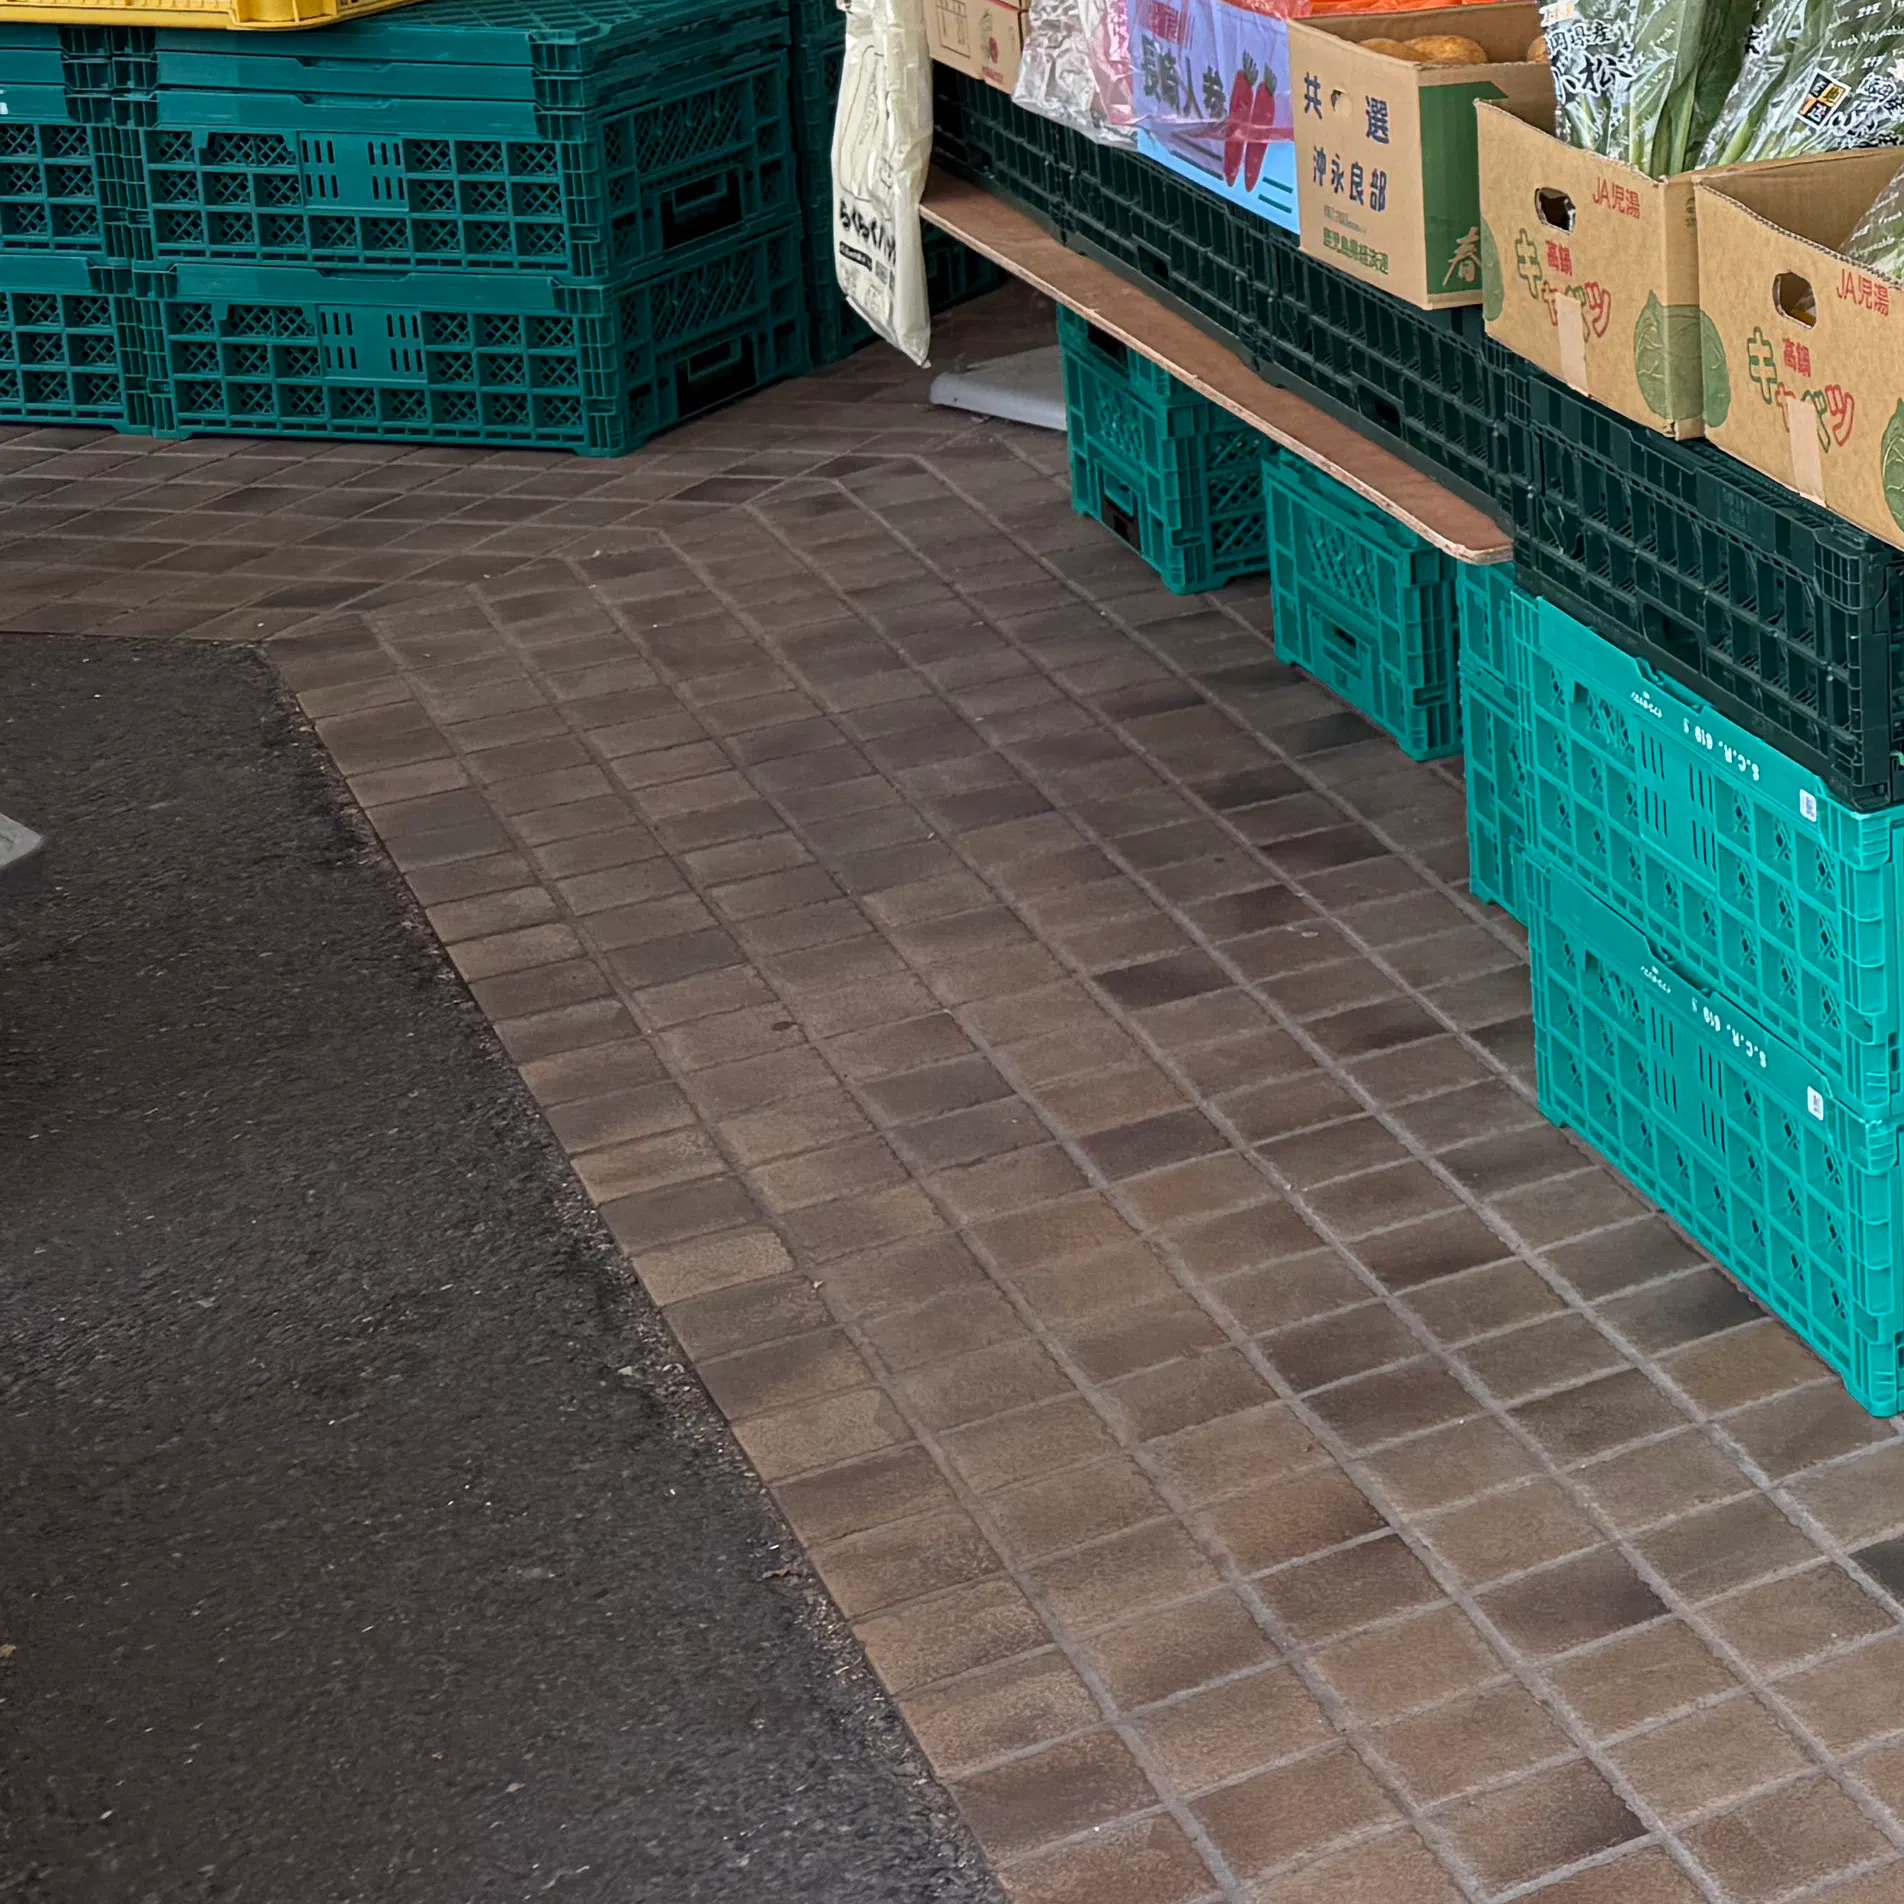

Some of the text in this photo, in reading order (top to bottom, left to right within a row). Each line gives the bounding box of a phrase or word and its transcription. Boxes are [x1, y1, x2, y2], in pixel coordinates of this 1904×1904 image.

[1313, 145, 1388, 213] 沖永良部
[1592, 176, 1641, 219] JA児湯
[1545, 239, 1573, 276] 高鍋
[1837, 268, 1890, 317] JA児湯
[1782, 336, 1812, 378] 高鍋
